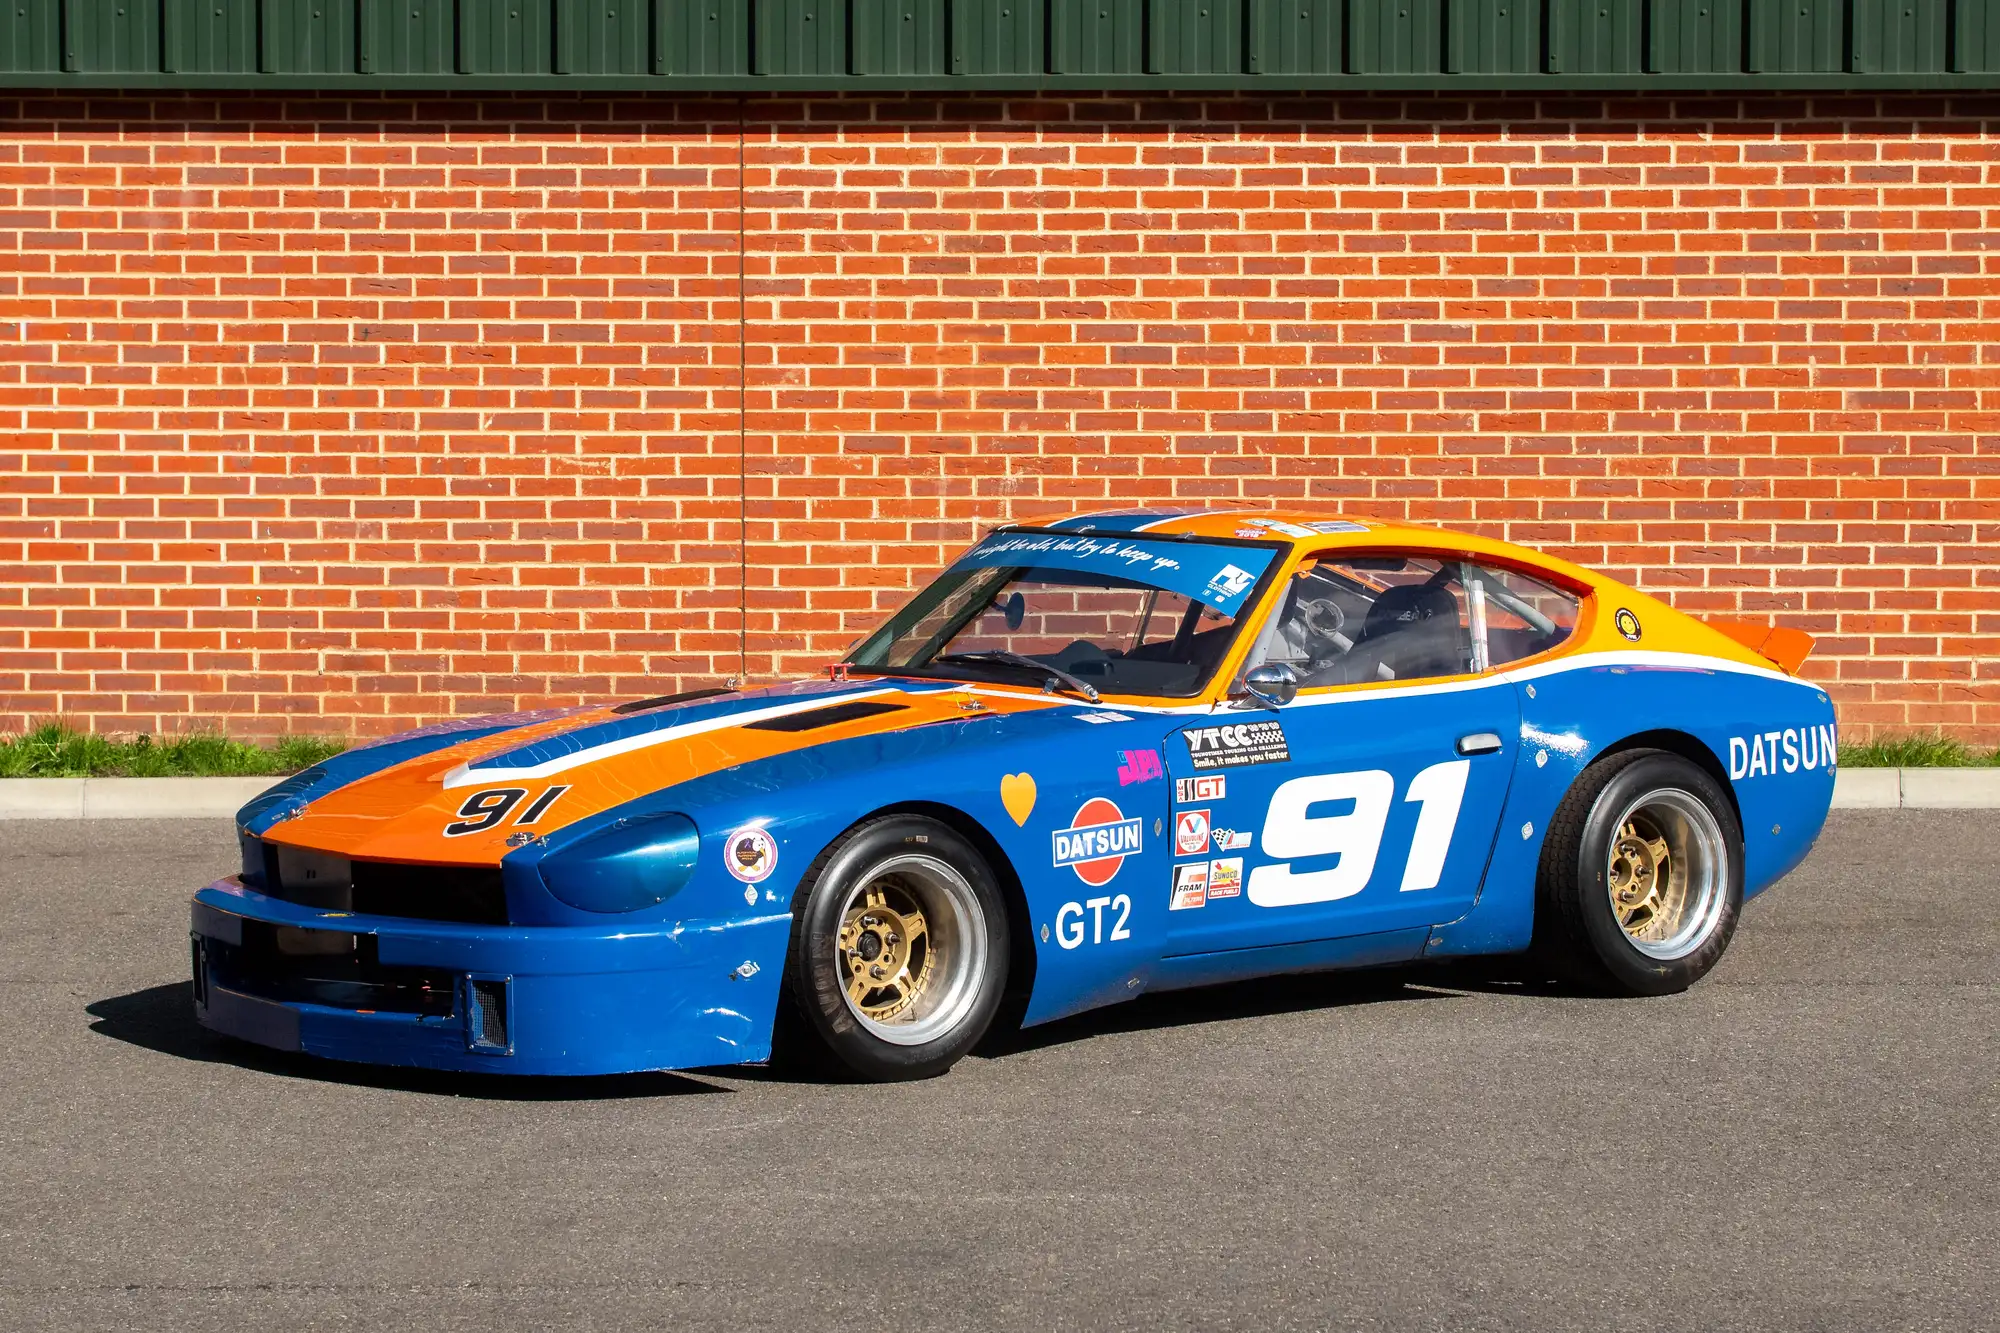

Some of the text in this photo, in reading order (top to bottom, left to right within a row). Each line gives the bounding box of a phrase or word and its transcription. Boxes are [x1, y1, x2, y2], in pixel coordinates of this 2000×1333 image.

[1052, 538, 1088, 551] but
[1073, 538, 1103, 559] try
[1099, 542, 1117, 555] to
[1117, 545, 1154, 565] keep
[1150, 554, 1181, 571] up.
[1182, 724, 1253, 751] YTCC
[1729, 723, 1837, 781] DATSUN
[1193, 751, 1288, 768] Smile, it makes you faster
[1197, 777, 1224, 797] GT
[442, 784, 574, 838] 91
[1056, 824, 1138, 861] DATSUN
[1247, 759, 1470, 907] 91
[1178, 883, 1202, 893] FRAM
[1213, 870, 1238, 880] SUNOCO
[1056, 893, 1131, 950] GT2
